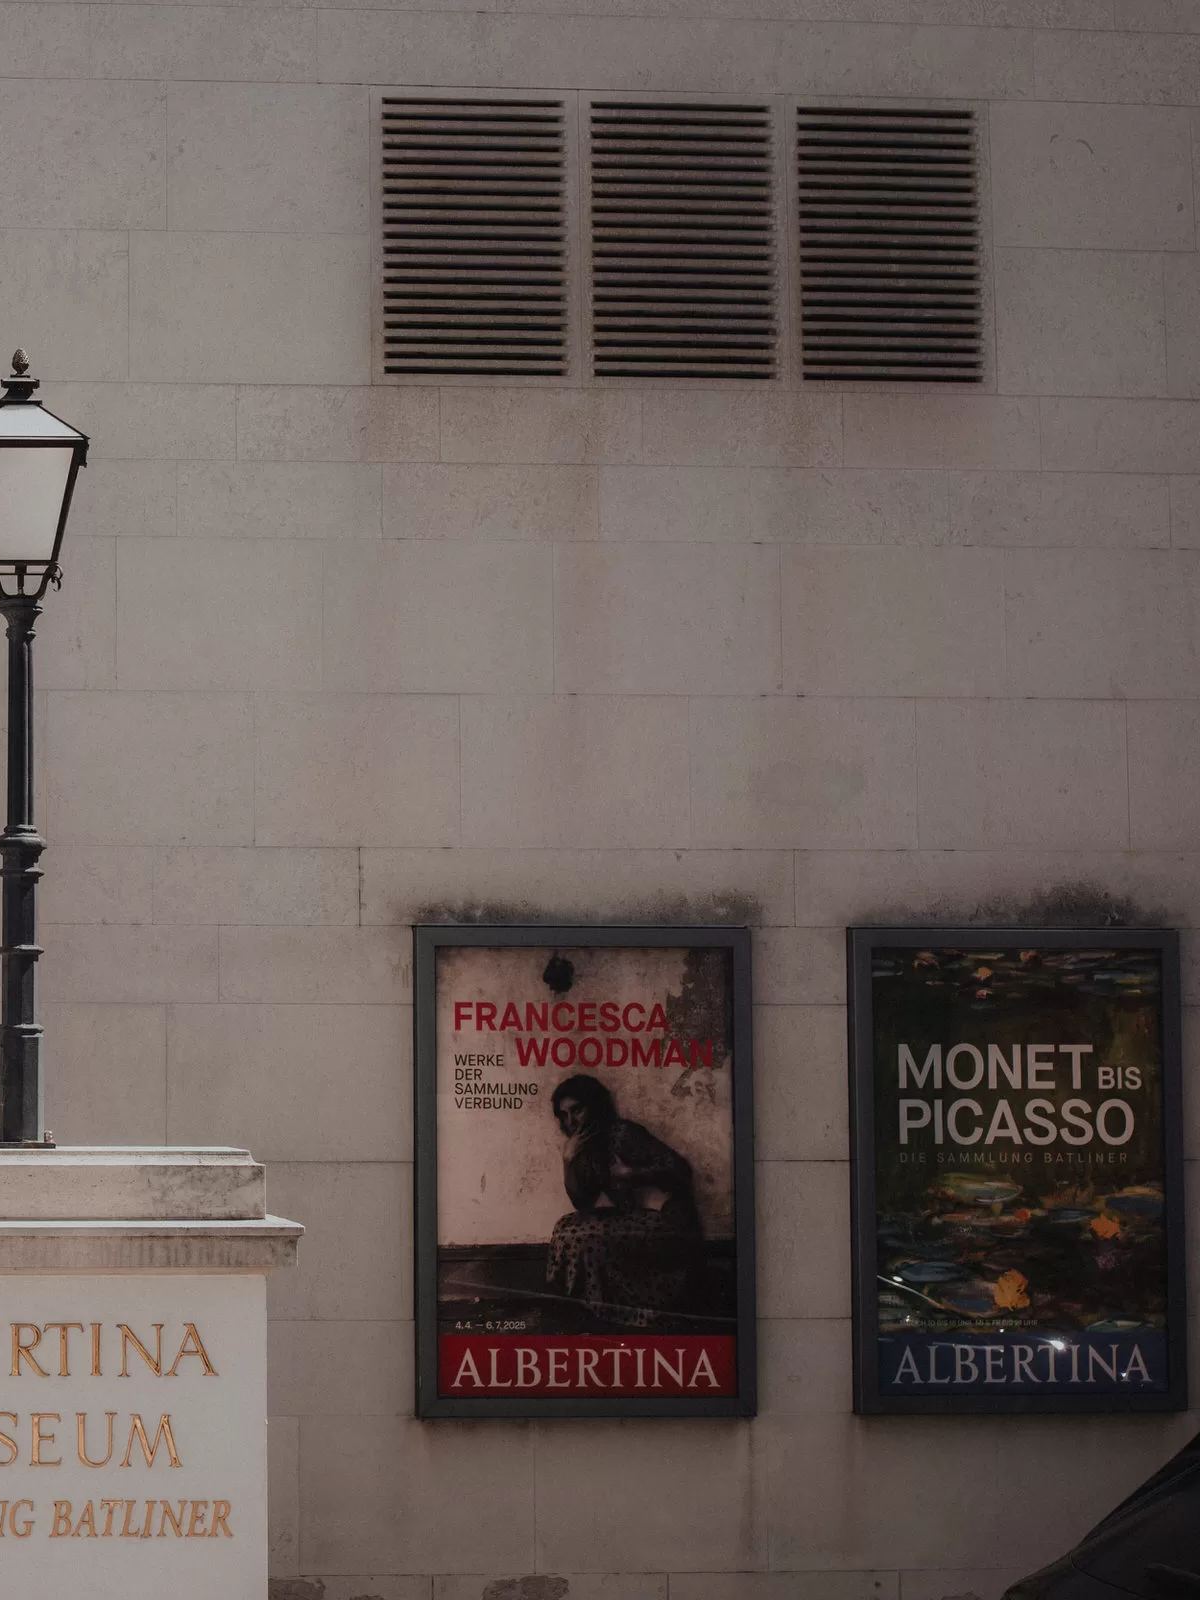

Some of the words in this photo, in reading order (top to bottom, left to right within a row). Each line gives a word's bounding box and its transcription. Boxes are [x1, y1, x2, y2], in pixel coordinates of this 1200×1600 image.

[454, 1001, 671, 1033] FRANCESCA
[454, 1054, 504, 1068] WERKE
[515, 1036, 714, 1069] WOODMAN
[898, 1043, 1094, 1090] MONET
[1098, 1066, 1142, 1090] BIS
[454, 1083, 539, 1096] SAMMLUNG
[455, 1068, 483, 1082] DER
[455, 1097, 524, 1110] VERBUND
[899, 1098, 1136, 1146] PICASSO
[899, 1152, 927, 1164] DIE
[936, 1152, 1033, 1164] SAMMLUNG
[1044, 1152, 1128, 1164] BATLINER
[455, 1320, 473, 1330] 4.4.
[486, 1320, 526, 1330] 6.7.2025
[451, 1347, 721, 1388] ALBERTINA
[892, 1343, 1153, 1385] ALBERTINA
[48, 1499, 234, 1539] BATLINER
